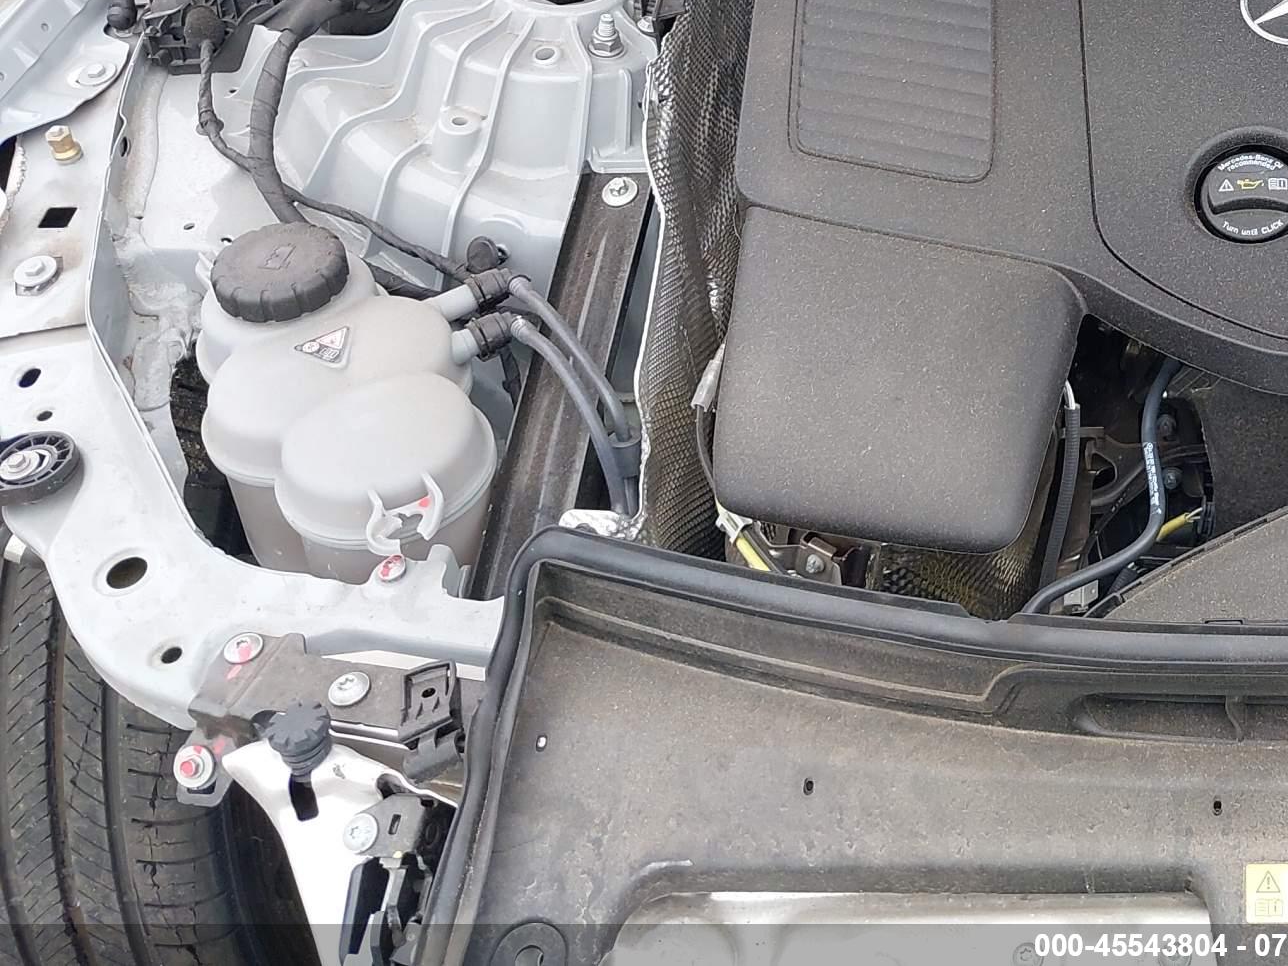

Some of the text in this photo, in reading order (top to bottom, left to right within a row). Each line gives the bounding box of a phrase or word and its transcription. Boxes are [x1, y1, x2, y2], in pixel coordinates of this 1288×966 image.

[1227, 160, 1276, 172] recommended
[1222, 219, 1284, 236] Turn until CLICK
